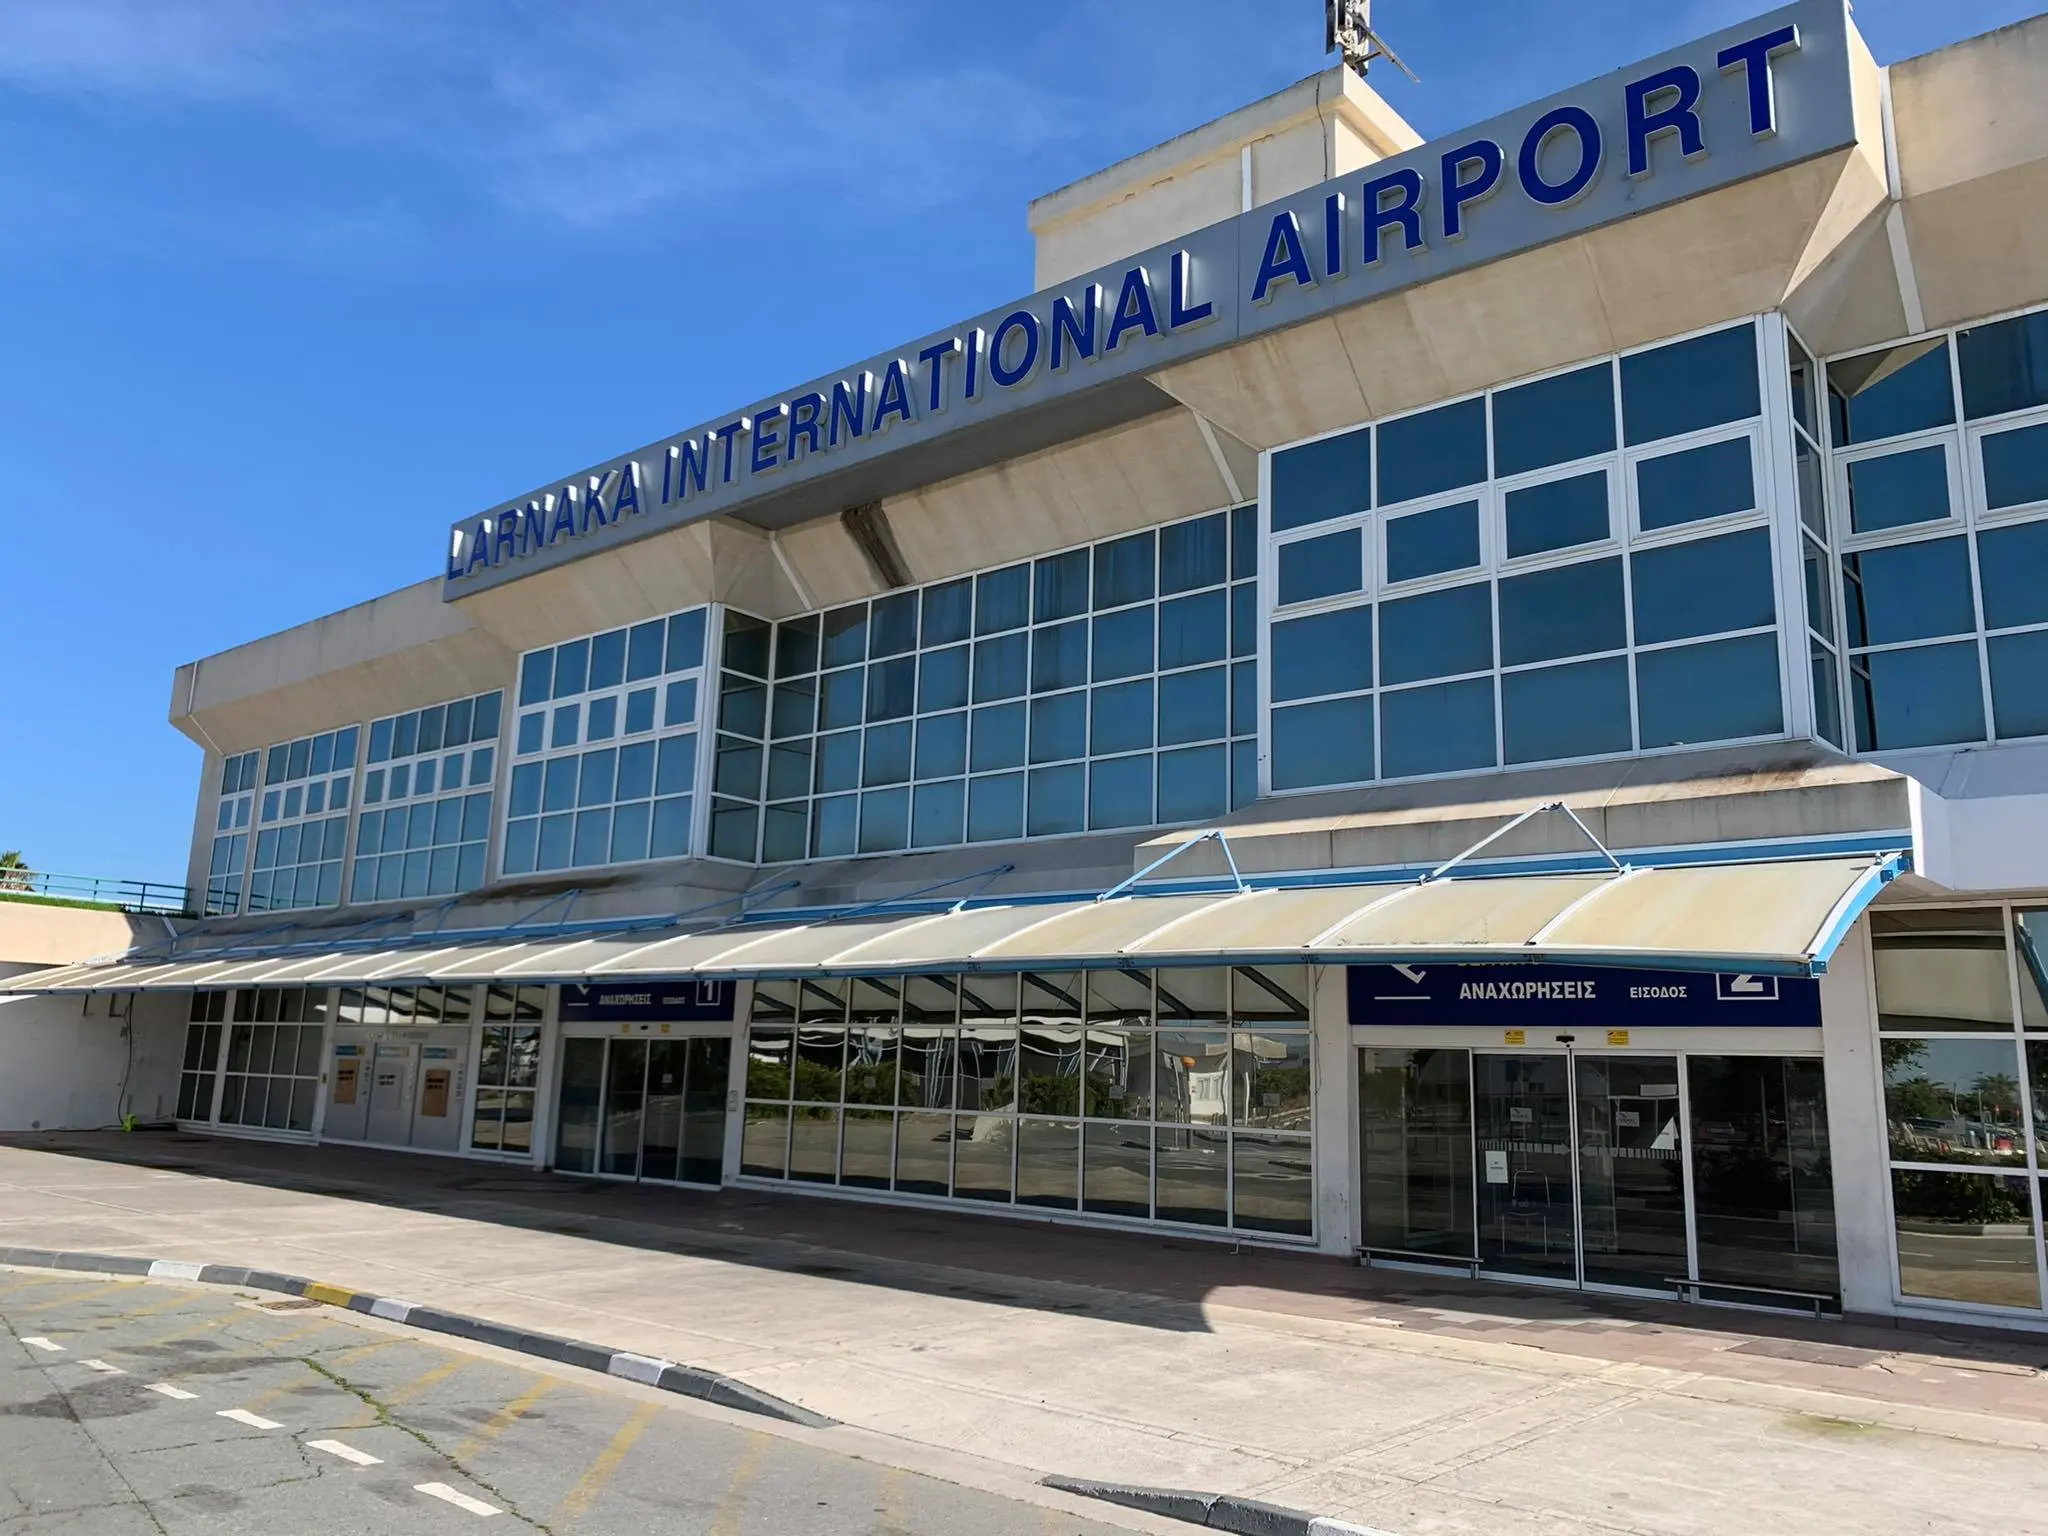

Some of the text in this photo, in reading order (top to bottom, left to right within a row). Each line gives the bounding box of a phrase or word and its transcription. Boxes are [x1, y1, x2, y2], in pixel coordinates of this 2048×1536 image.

[447, 24, 1800, 581] LARNAKA INTERNATIONAL AIRPORT
[703, 979, 713, 1001] 1
[1459, 980, 1688, 1000] ΑΝΑΧΩΡΗΣΕΙΣ ΕΙΣΟΔΟΣ
